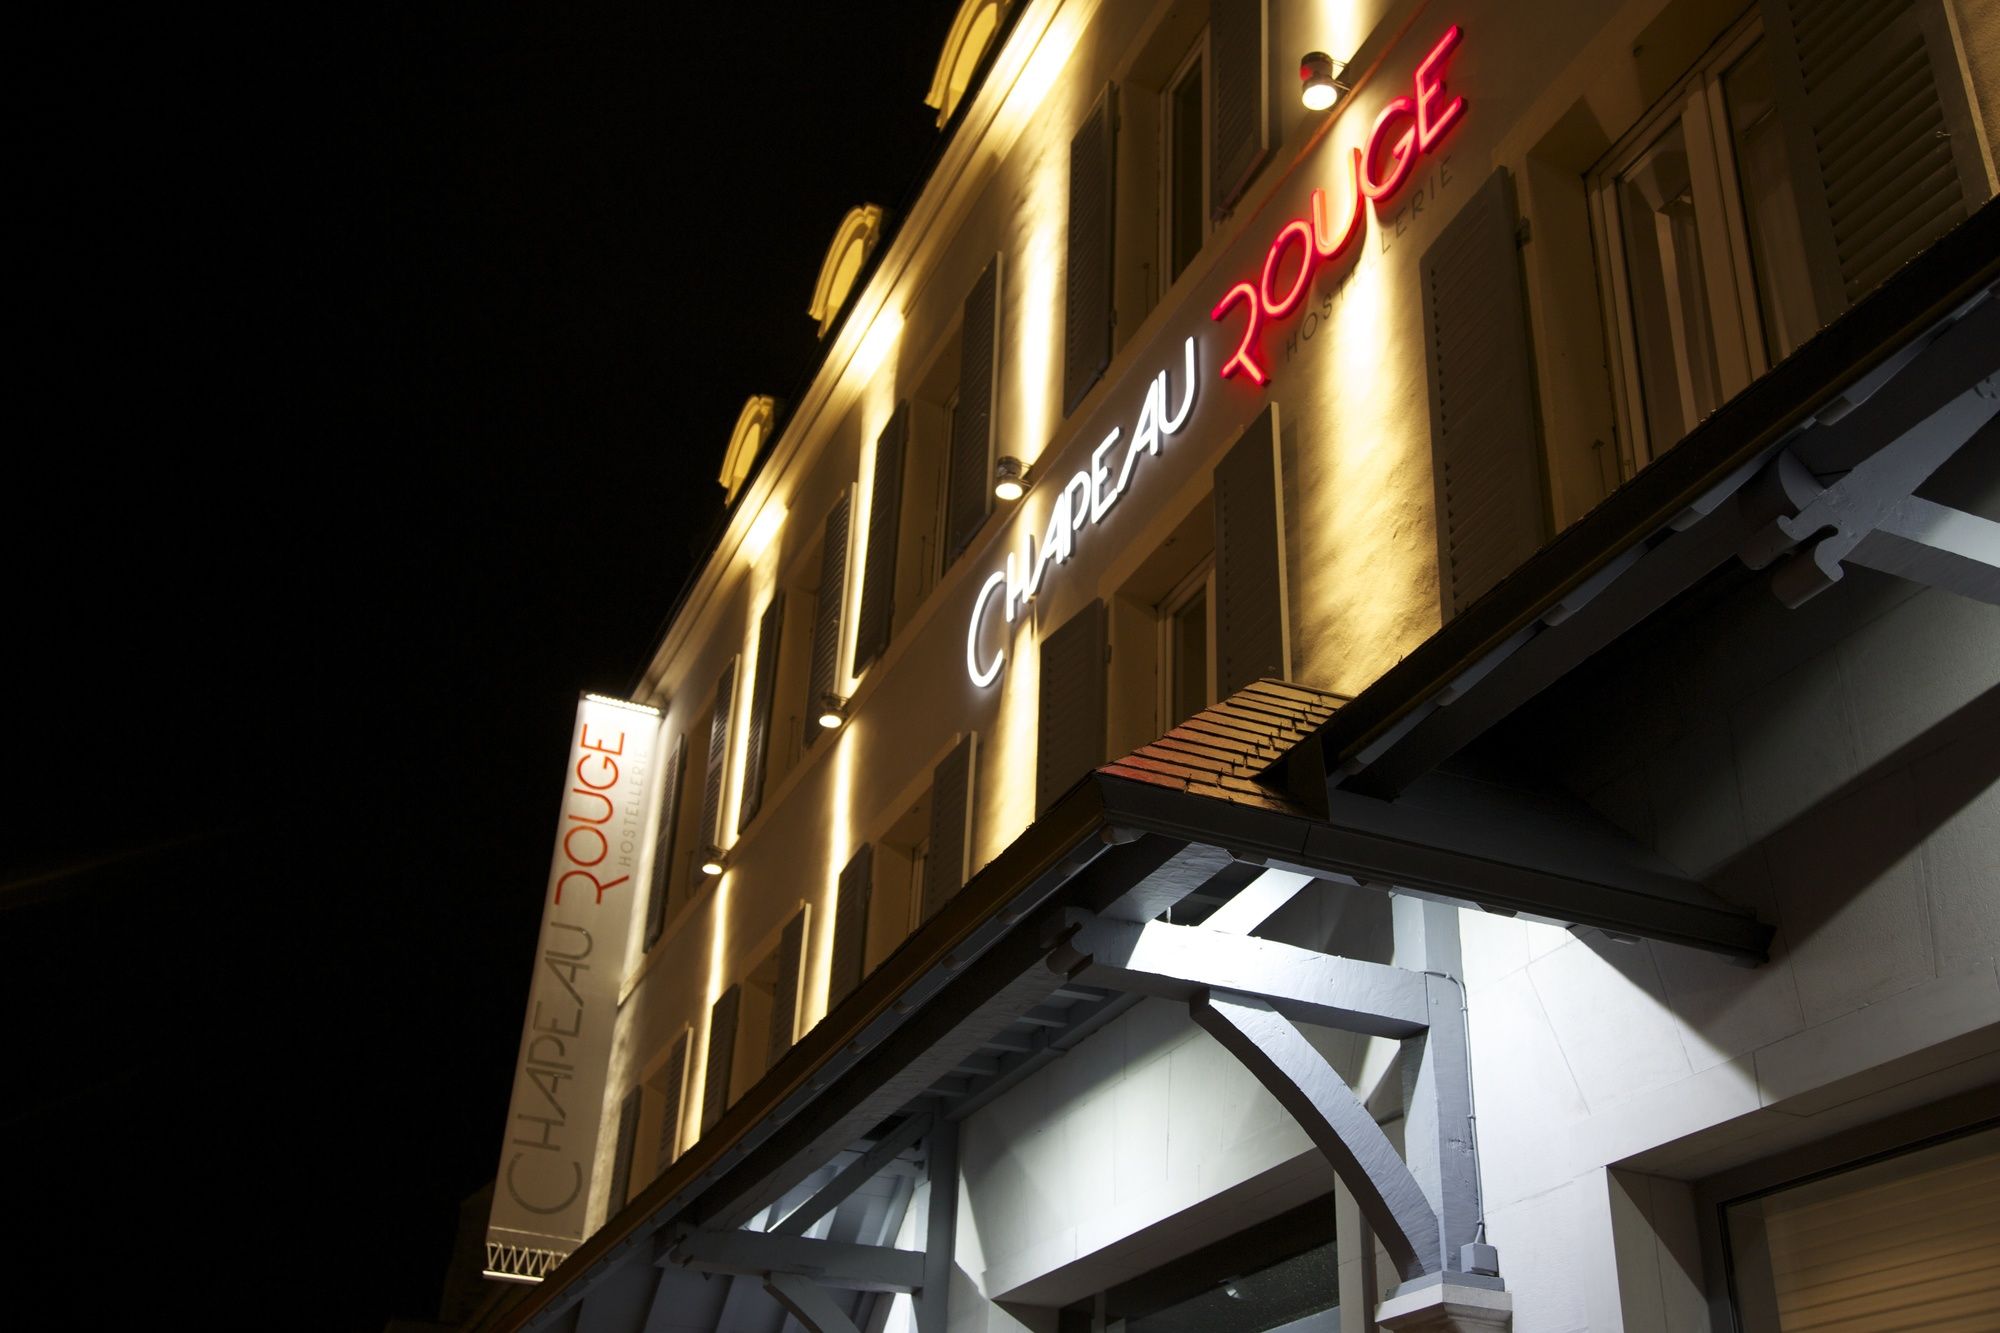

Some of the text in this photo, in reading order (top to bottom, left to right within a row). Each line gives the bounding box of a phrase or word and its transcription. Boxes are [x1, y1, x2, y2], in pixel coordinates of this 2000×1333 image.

[967, 24, 1468, 689] CHAPEAU ROUGE
[1285, 155, 1453, 362] HOSTLERIE
[507, 723, 630, 1215] CHAPEAU ROUGE
[617, 751, 648, 868] HOSTELLERIE
